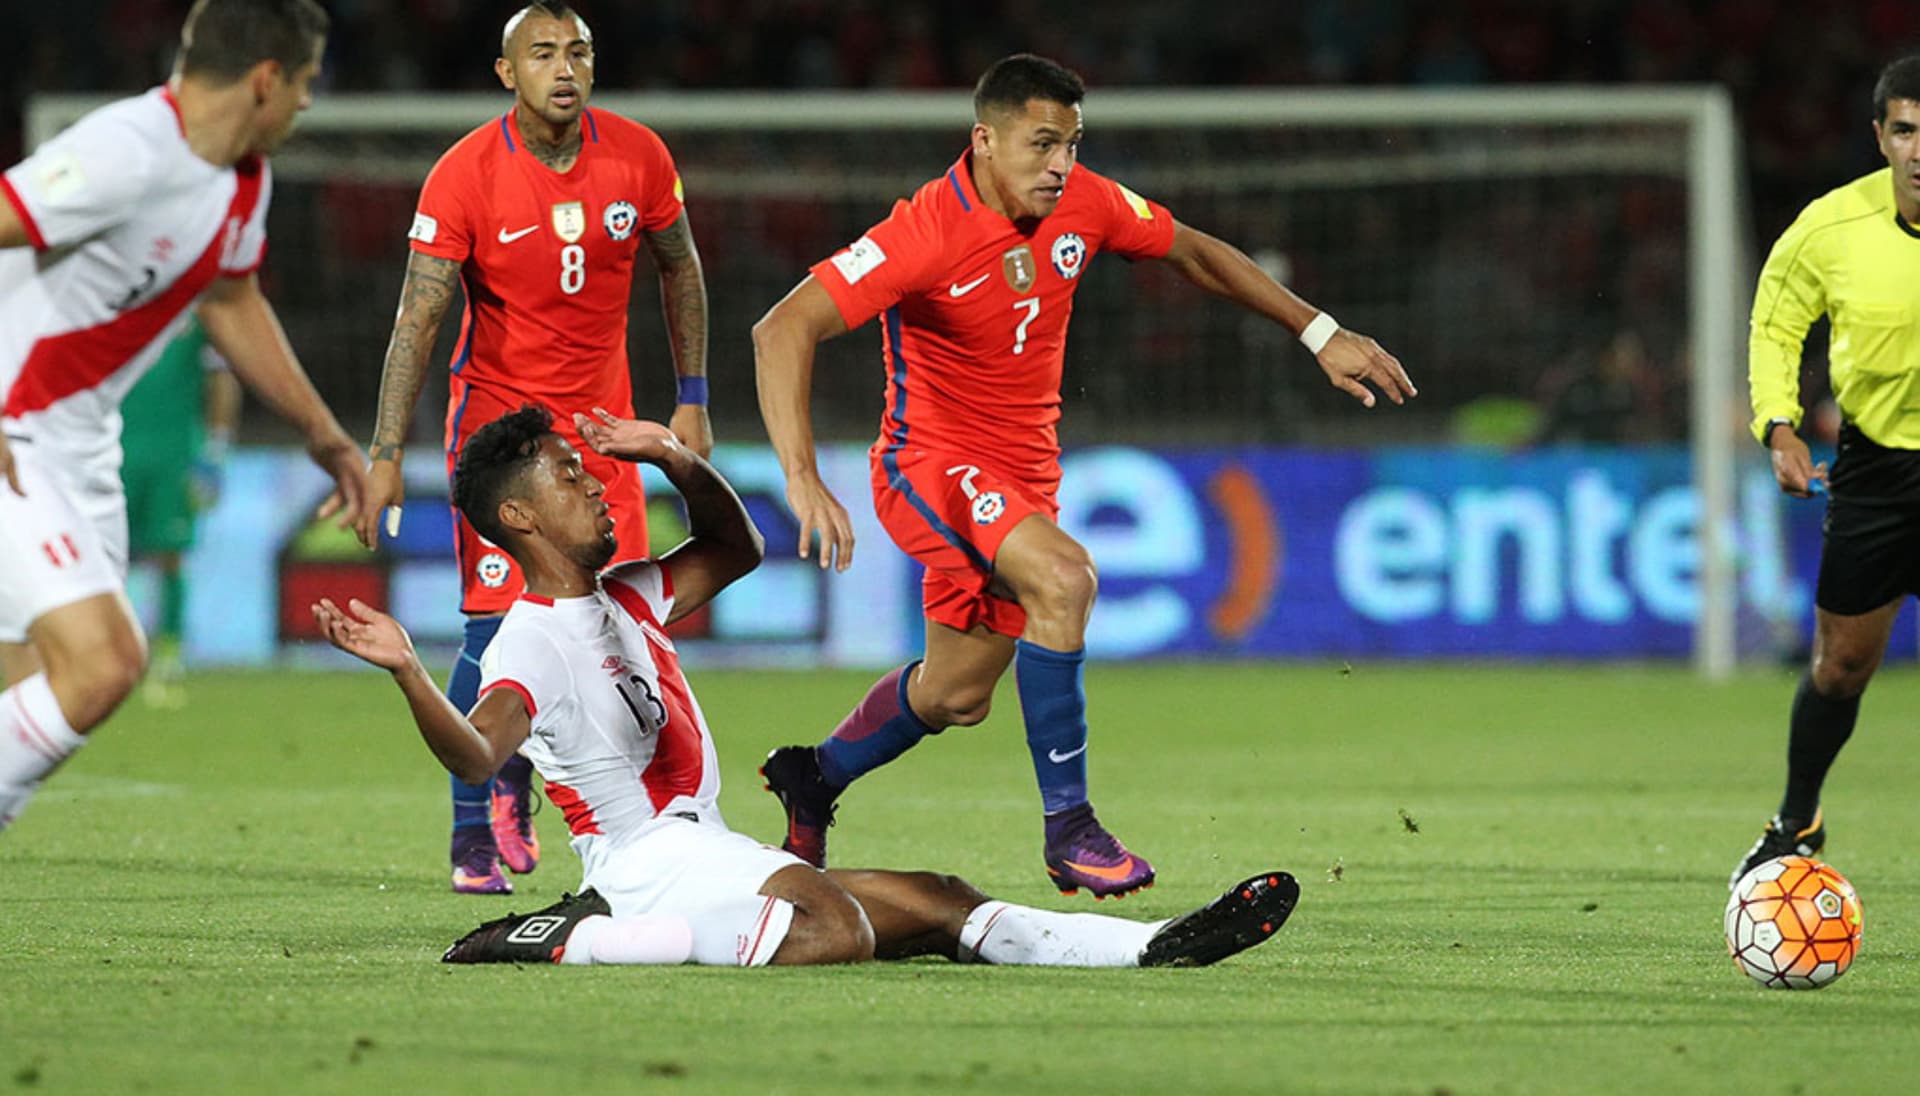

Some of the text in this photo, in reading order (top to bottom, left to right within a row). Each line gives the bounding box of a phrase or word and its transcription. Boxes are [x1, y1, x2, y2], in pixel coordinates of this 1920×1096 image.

[561, 244, 586, 294] 8
[1013, 296, 1041, 354] 7
[945, 464, 980, 500] 7
[1334, 468, 1808, 624] entel
[615, 674, 668, 736] 13
